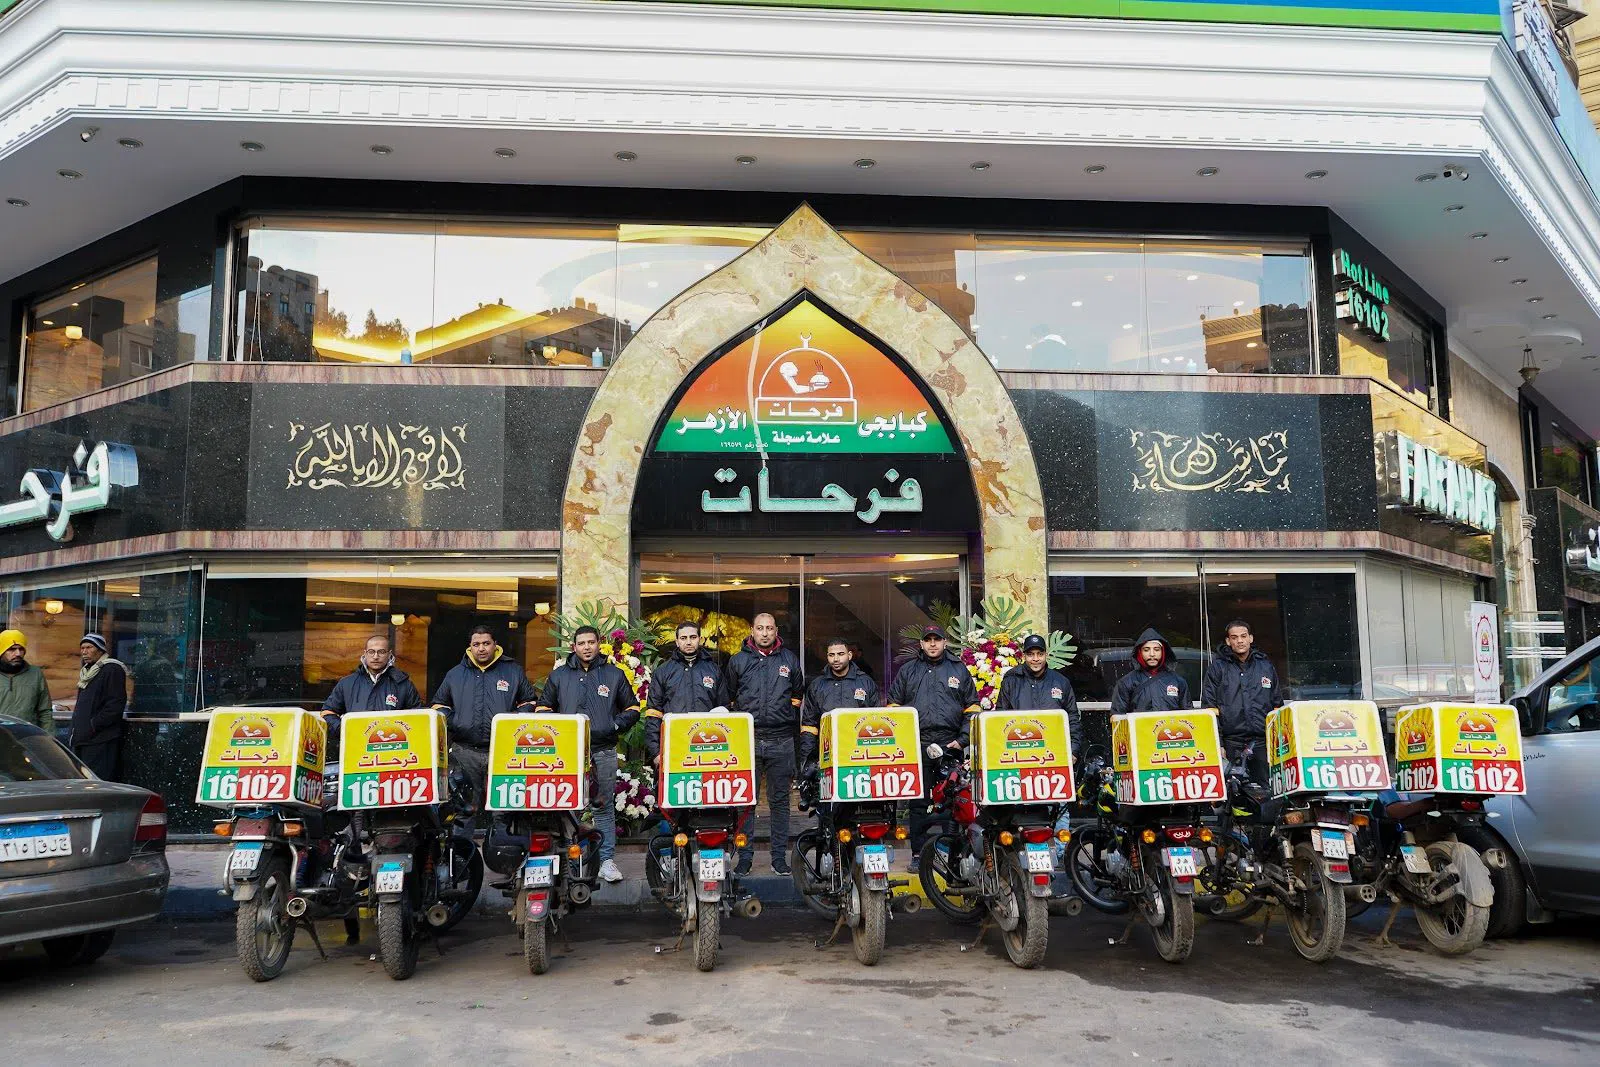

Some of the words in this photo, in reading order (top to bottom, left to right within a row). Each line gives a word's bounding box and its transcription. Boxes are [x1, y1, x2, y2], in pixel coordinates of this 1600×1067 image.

[1341, 248, 1363, 287] Hot
[1365, 267, 1390, 305] Line
[1347, 287, 1391, 341] 16102
[769, 401, 843, 421] فرحات
[772, 431, 805, 445] مسجلة
[806, 431, 841, 445] علامة
[701, 467, 923, 524] فرحات
[236, 738, 265, 746] فرحات
[1313, 740, 1368, 754] فرحات
[1453, 743, 1507, 757] فرحات
[220, 749, 279, 763] فرحات
[358, 752, 418, 768] فرحات
[507, 757, 565, 772] فرحات
[683, 753, 738, 769] فرحات
[850, 748, 905, 763] فرحات
[1000, 750, 1055, 765] فرحات
[1151, 750, 1206, 765] فرحات
[207, 773, 286, 800] 16102
[842, 771, 916, 798] 16102
[992, 774, 1067, 801] 16102
[1144, 773, 1219, 800] 16102
[1273, 766, 1297, 796] 1602
[1307, 762, 1383, 788] 16102
[1398, 766, 1434, 791] 16102
[1446, 765, 1519, 791] 16102
[348, 777, 428, 806] 16102
[495, 782, 574, 808] 16102
[673, 777, 748, 805] 16102
